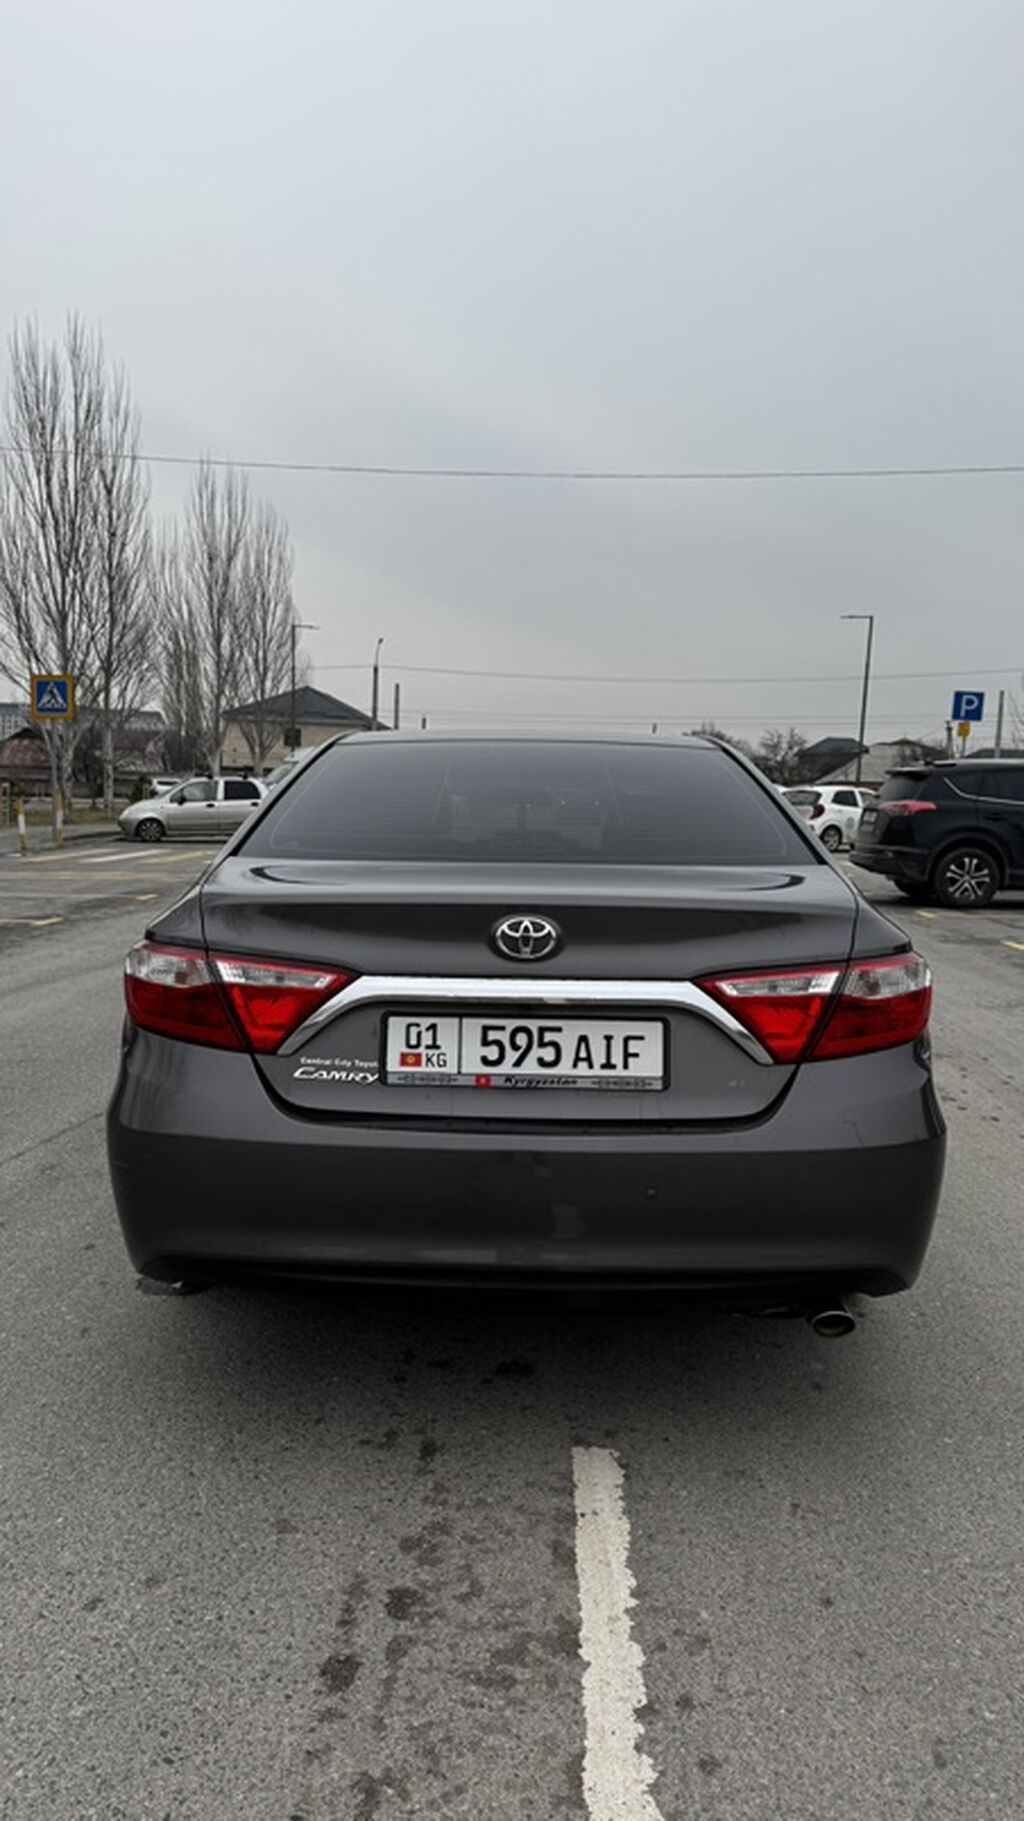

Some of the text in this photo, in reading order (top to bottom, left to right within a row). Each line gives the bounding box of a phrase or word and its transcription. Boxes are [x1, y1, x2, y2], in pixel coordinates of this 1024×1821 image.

[960, 695, 979, 717] P
[405, 1022, 441, 1050] 01
[479, 1025, 646, 1070] 595 AIF
[424, 1052, 448, 1068] KG
[292, 1066, 380, 1084] CAMRY
